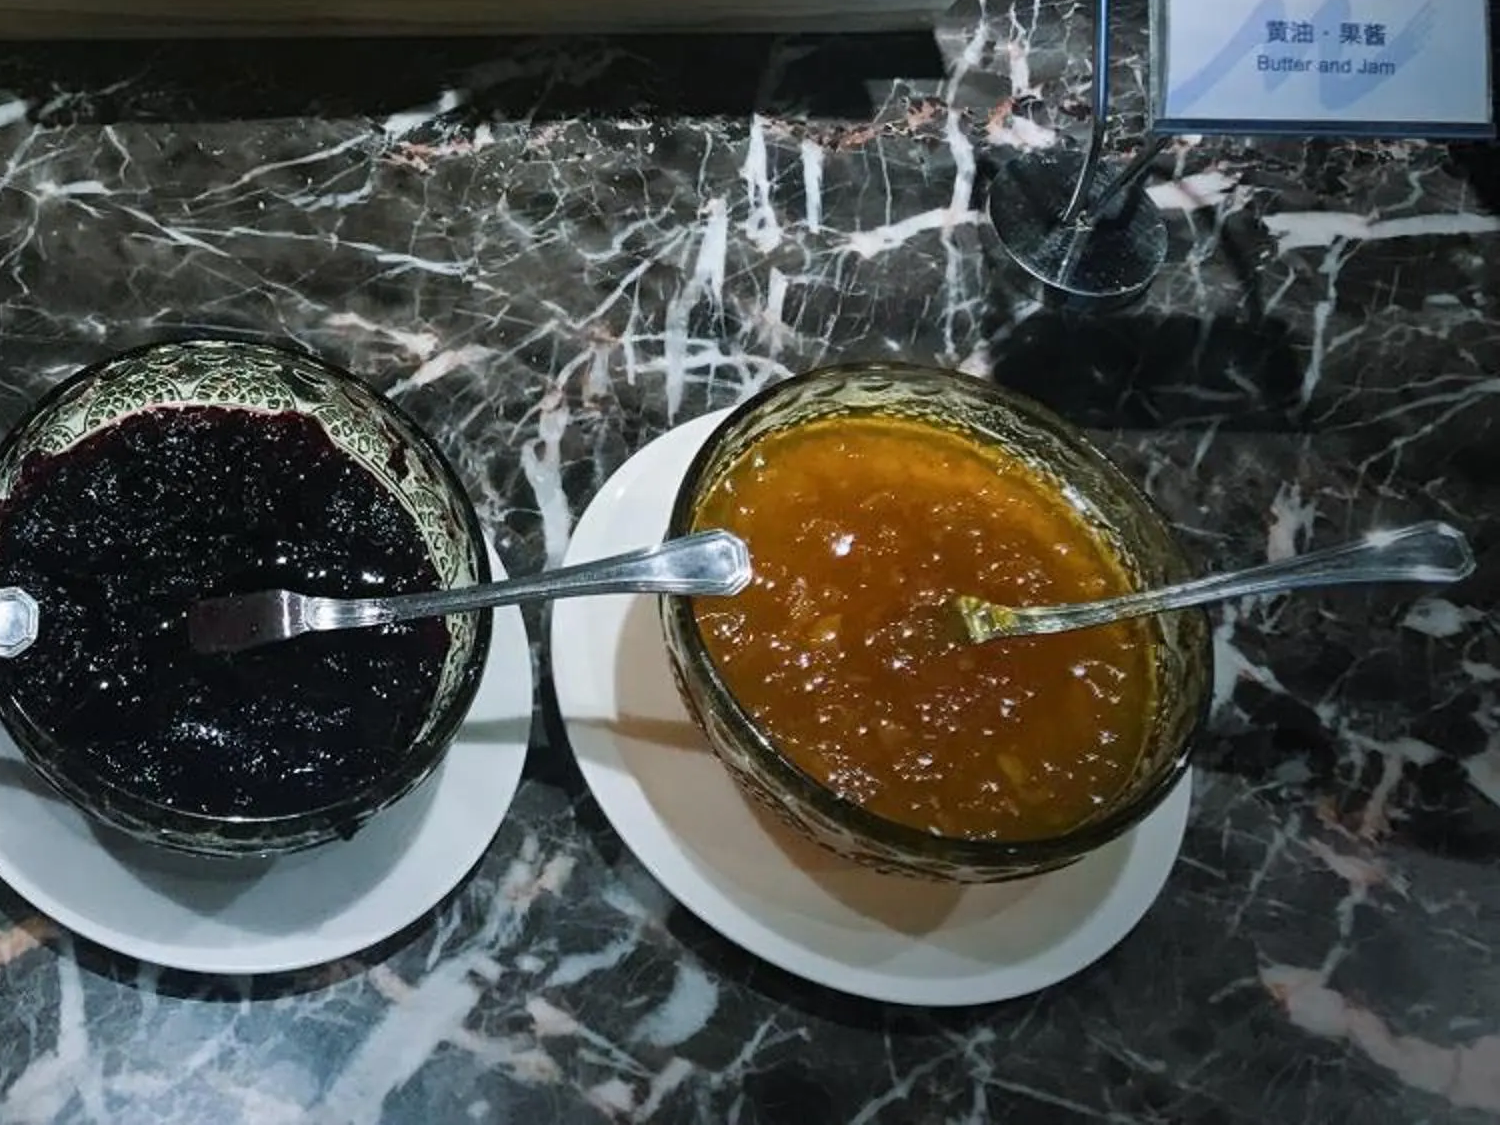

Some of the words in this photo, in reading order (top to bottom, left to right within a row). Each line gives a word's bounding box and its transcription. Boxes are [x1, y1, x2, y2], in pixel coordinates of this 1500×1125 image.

[1257, 54, 1311, 72] Butter
[1319, 58, 1351, 74] and
[1357, 60, 1396, 75] Jam
